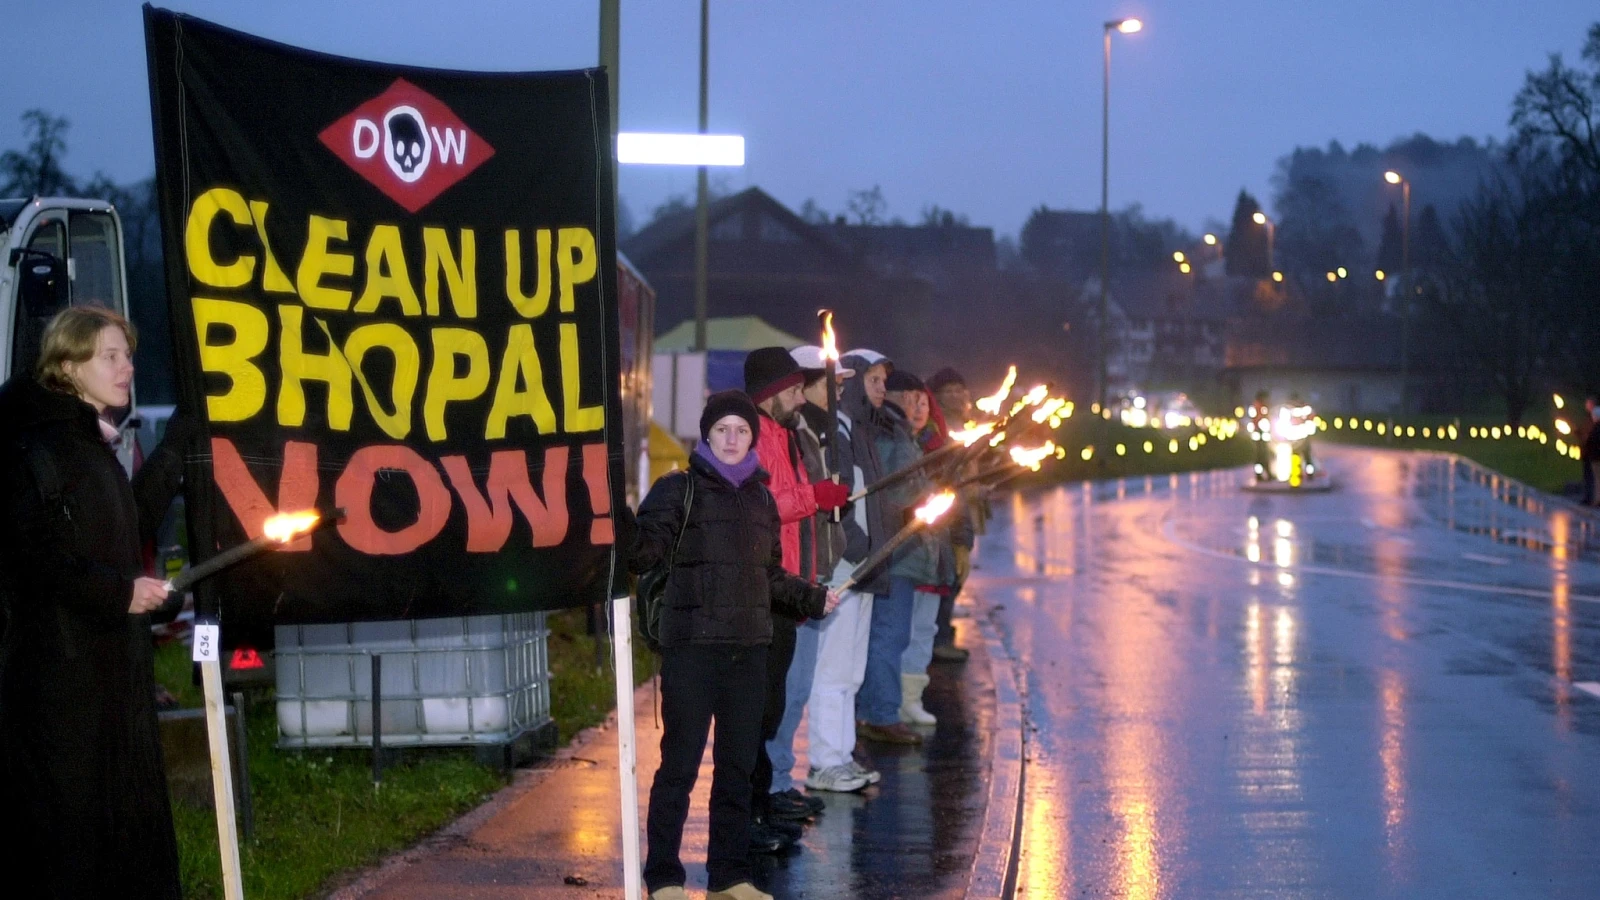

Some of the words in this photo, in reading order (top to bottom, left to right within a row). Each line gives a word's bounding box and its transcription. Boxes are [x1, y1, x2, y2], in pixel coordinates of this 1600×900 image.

[353, 105, 467, 183] DOW
[185, 187, 478, 319] CLEAN
[505, 227, 597, 319] UP
[191, 297, 605, 442] BHOPAL
[211, 437, 615, 555] NOW!
